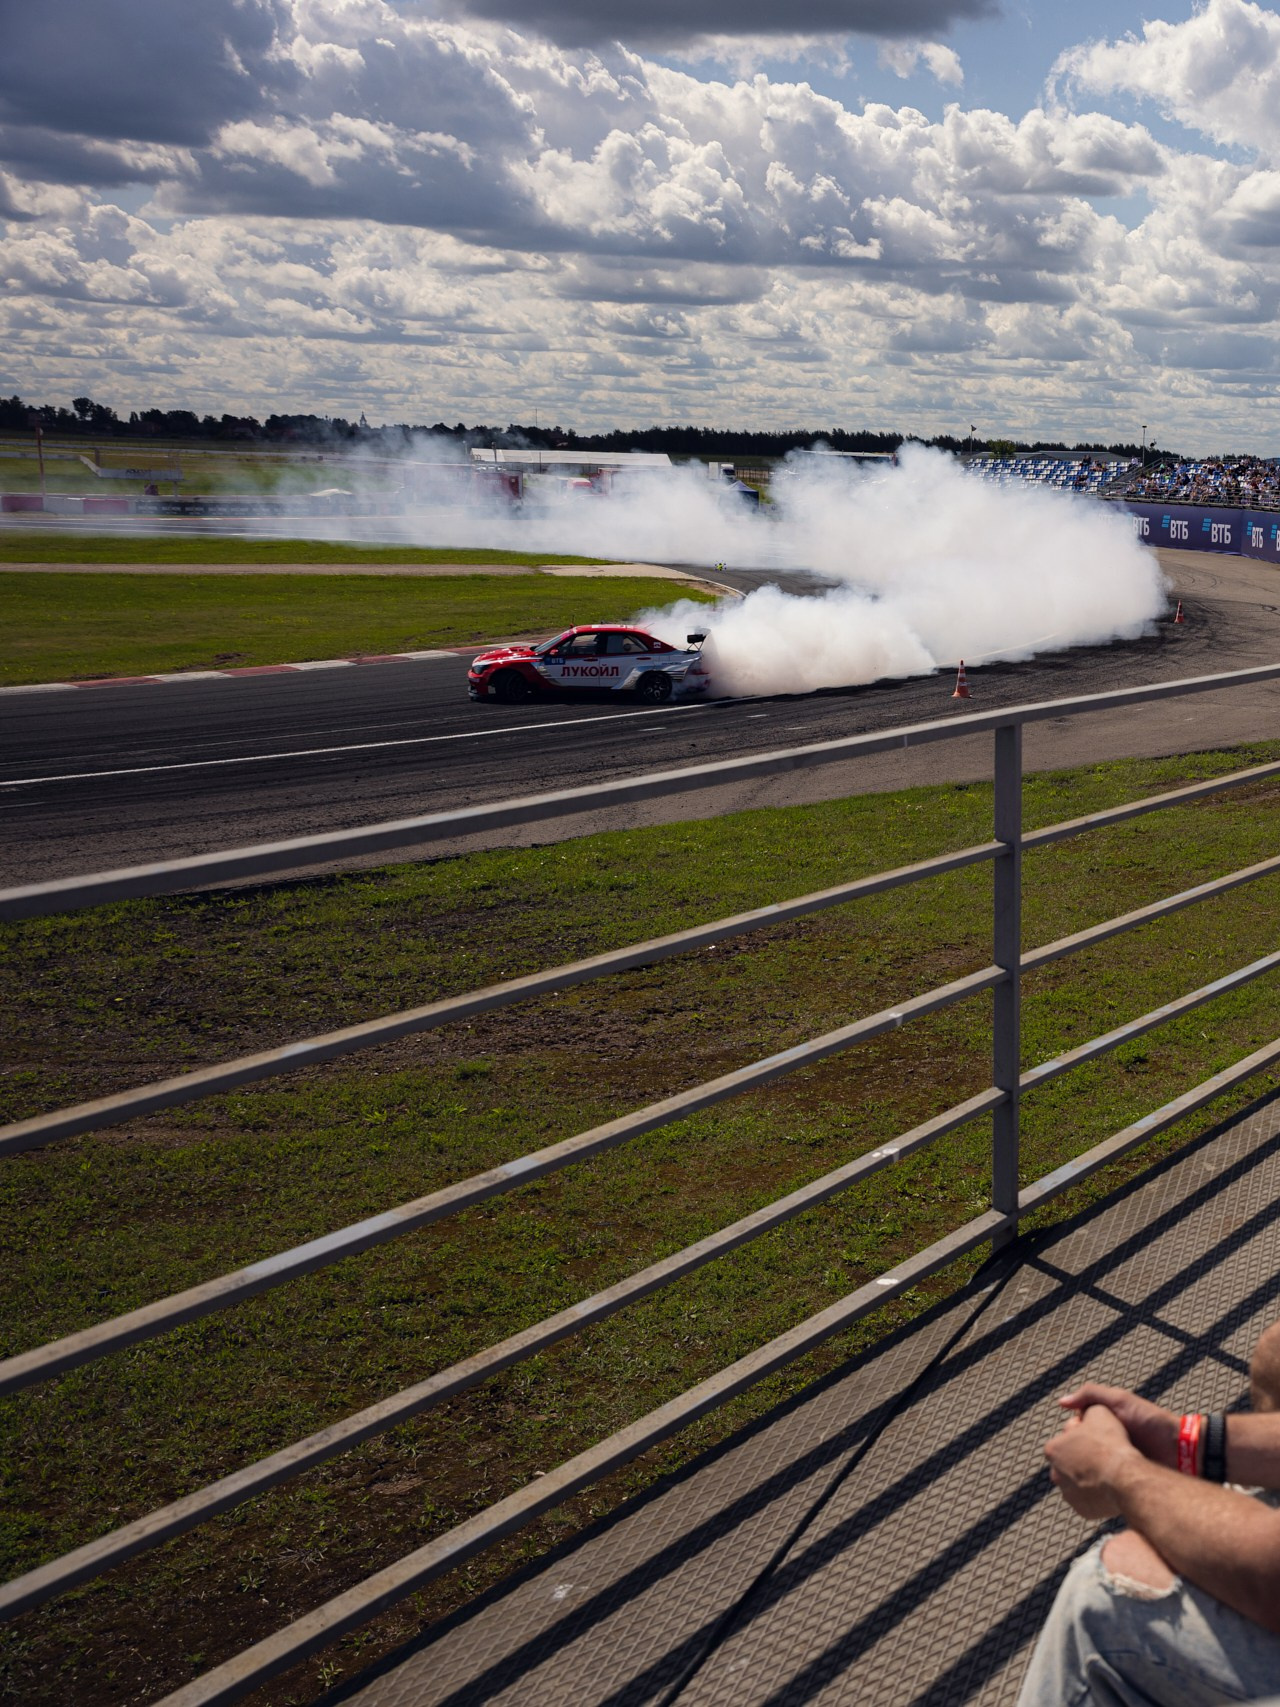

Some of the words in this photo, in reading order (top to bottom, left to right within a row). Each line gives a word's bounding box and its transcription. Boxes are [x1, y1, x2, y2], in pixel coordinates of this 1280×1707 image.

[1132, 517, 1150, 536] ВТБ
[1170, 519, 1189, 540] ВТБ
[1211, 523, 1232, 544] ВТБ
[1251, 526, 1264, 548] ВТБ
[561, 663, 619, 677] ЛУКОЙЛ
